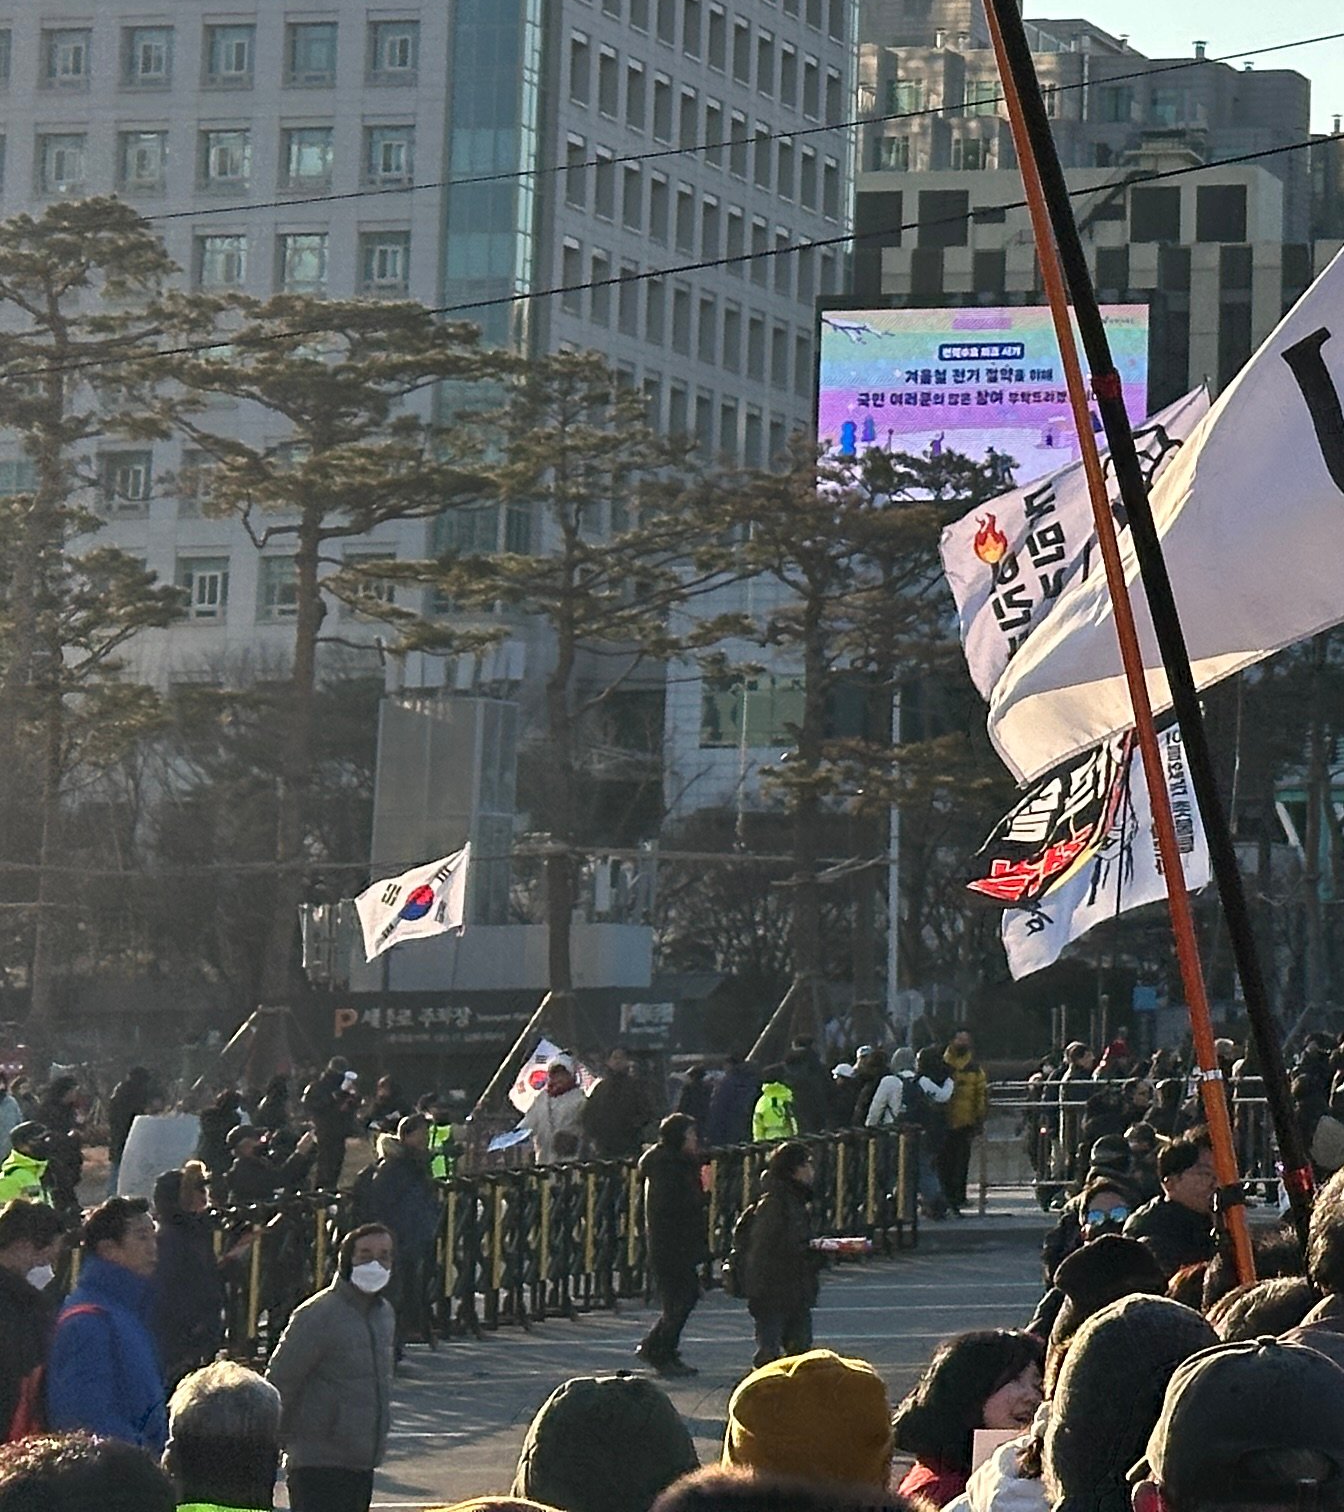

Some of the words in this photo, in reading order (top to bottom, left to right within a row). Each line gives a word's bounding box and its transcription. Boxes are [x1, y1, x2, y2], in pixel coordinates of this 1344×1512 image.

[952, 368, 980, 384] 전기
[857, 392, 885, 408] 국민
[890, 391, 945, 406] 여러분의
[975, 390, 1004, 406] 참여
